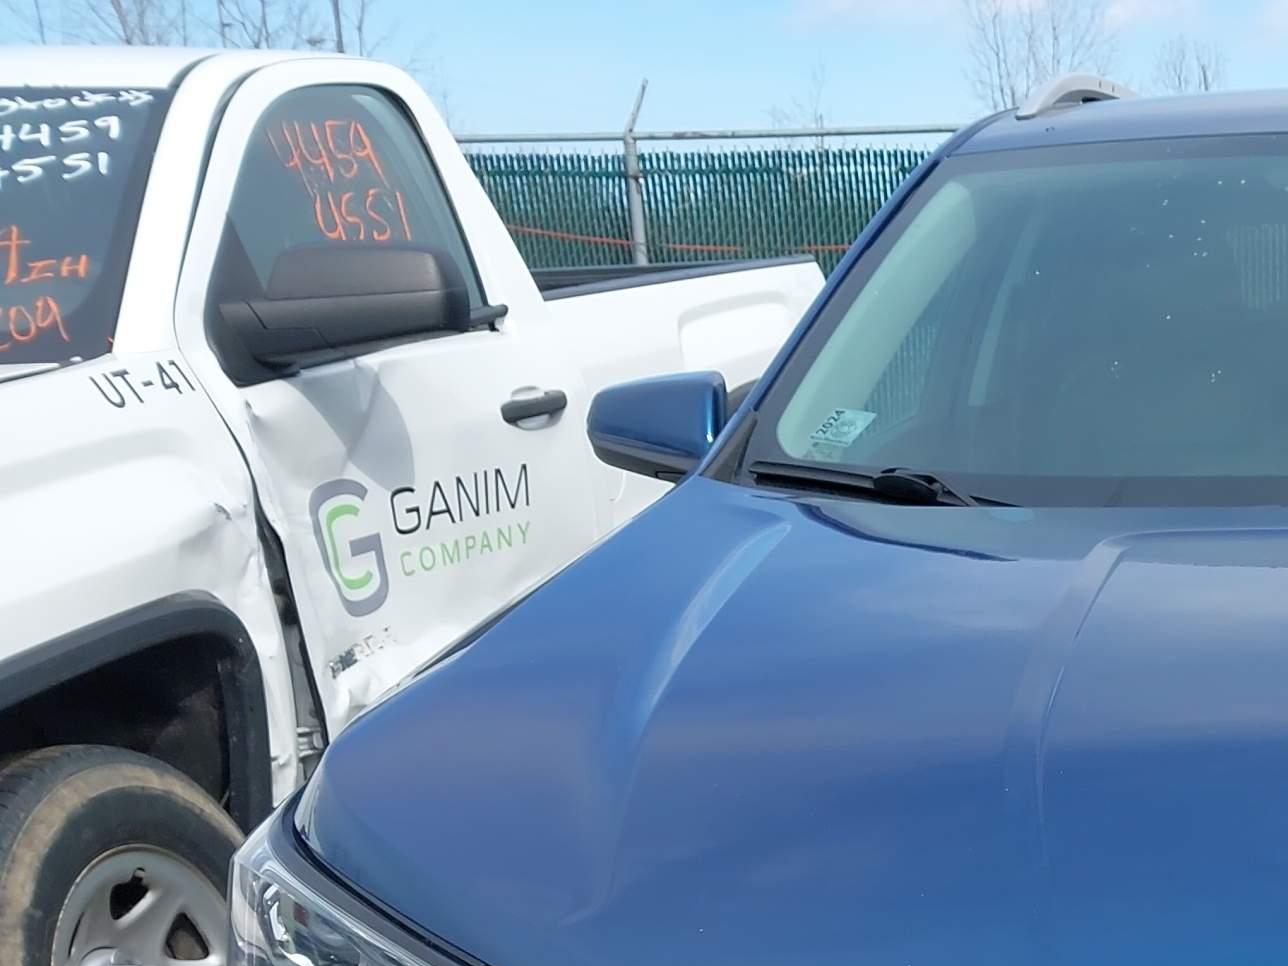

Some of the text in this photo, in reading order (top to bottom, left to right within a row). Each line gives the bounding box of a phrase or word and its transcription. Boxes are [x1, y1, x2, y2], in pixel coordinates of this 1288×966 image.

[0, 151, 109, 191] 551
[314, 188, 412, 240] 4551
[0, 295, 71, 352] 09
[88, 359, 197, 408] UT-41
[815, 409, 846, 436] 2024
[390, 463, 531, 535] GANIM
[399, 521, 531, 577] COMPANY
